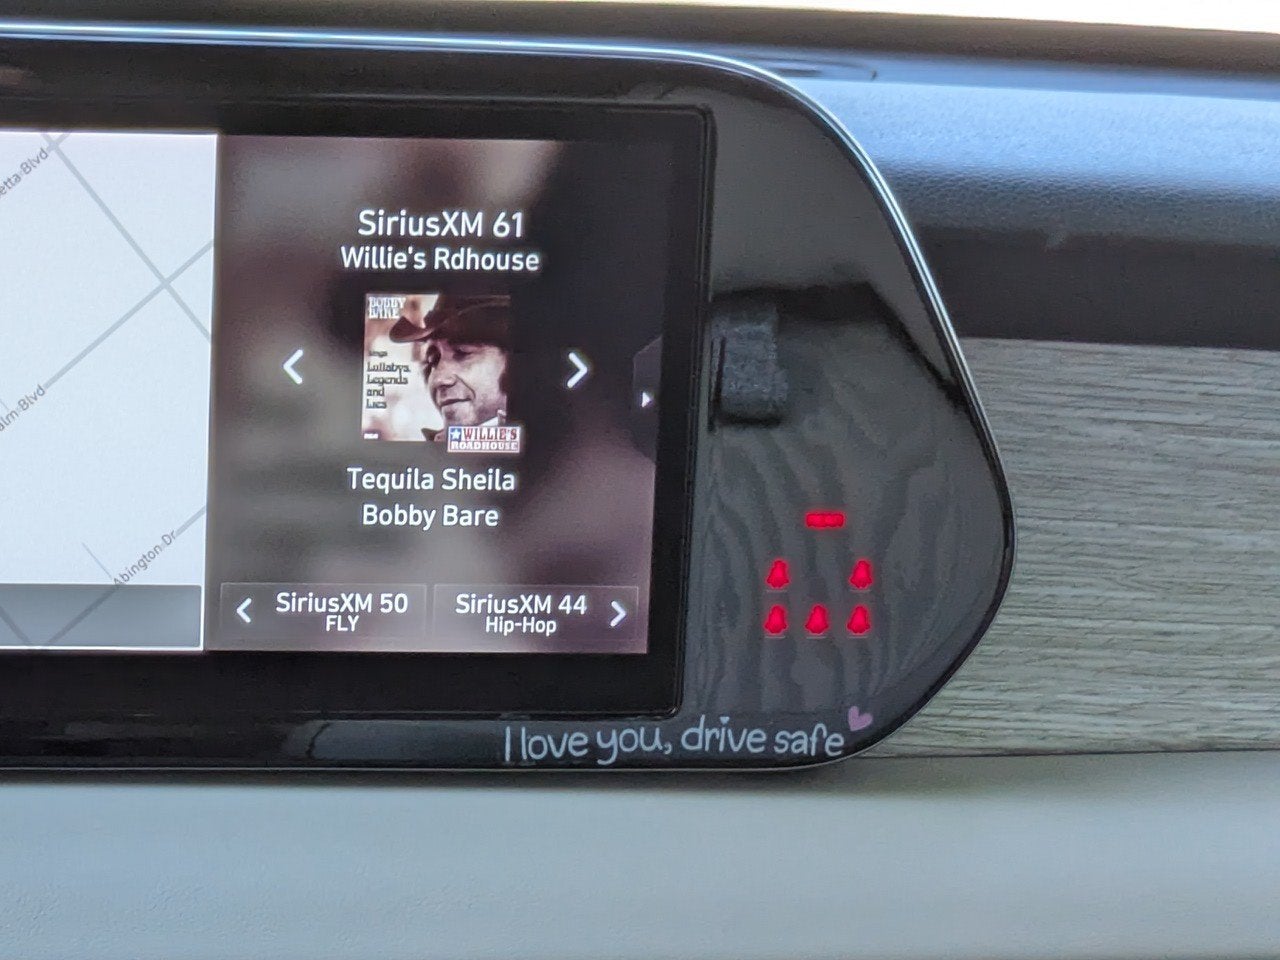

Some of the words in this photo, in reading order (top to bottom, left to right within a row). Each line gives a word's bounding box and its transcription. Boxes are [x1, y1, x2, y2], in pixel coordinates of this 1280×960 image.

[20, 147, 48, 175] Blvd
[357, 209, 483, 237] SiriusXM
[492, 211, 523, 238] 61
[340, 246, 427, 270] Willie's
[433, 247, 540, 271] Rdhouse
[17, 384, 46, 411] Blvd
[346, 467, 434, 494] Tequila
[441, 468, 516, 491] Sheila
[362, 504, 437, 531] Bobby
[442, 504, 500, 527] Bare
[161, 529, 176, 546] Dr
[275, 592, 373, 614] SiriusXM
[380, 593, 409, 614] 50
[455, 593, 552, 614] SiriusXM
[558, 595, 588, 615] 44
[325, 615, 360, 633] FLY
[485, 616, 557, 637] Hip-Hop
[520, 726, 589, 761] love
[596, 726, 673, 765] you,
[681, 714, 765, 754] drive
[773, 723, 845, 757] safe
